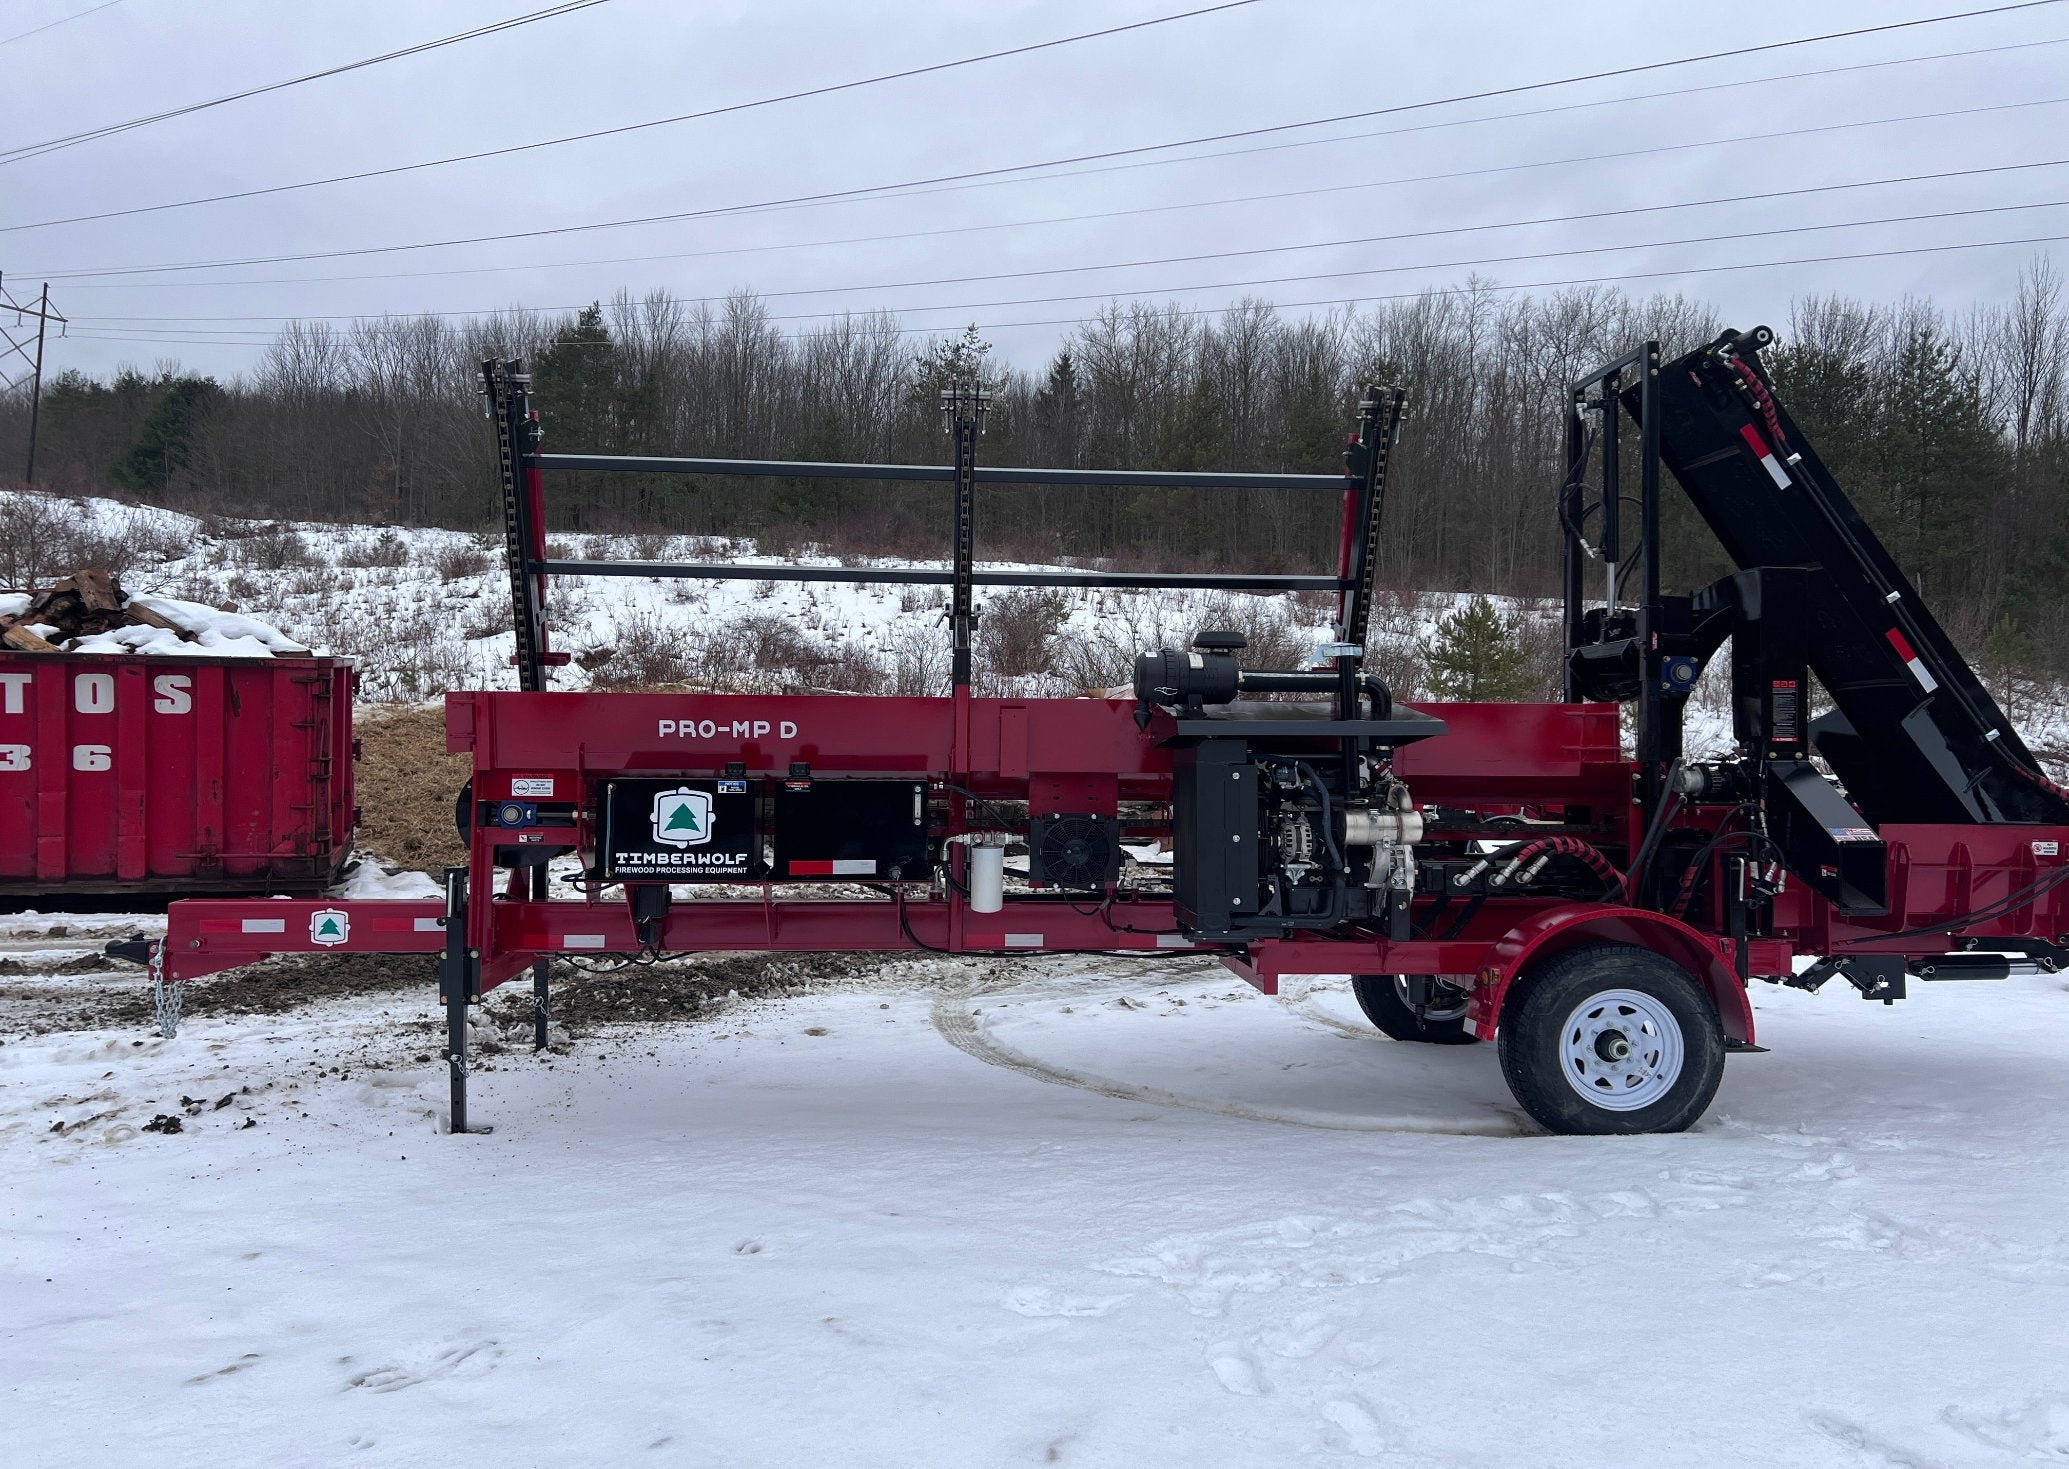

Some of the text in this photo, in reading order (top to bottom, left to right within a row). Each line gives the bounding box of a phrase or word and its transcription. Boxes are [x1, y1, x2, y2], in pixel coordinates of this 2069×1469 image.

[658, 719, 798, 739] PRO-MP D
[615, 852, 748, 865] TIMBERWOLF
[615, 866, 748, 875] FIREWOOD PROCESSING EQUIPMENT
